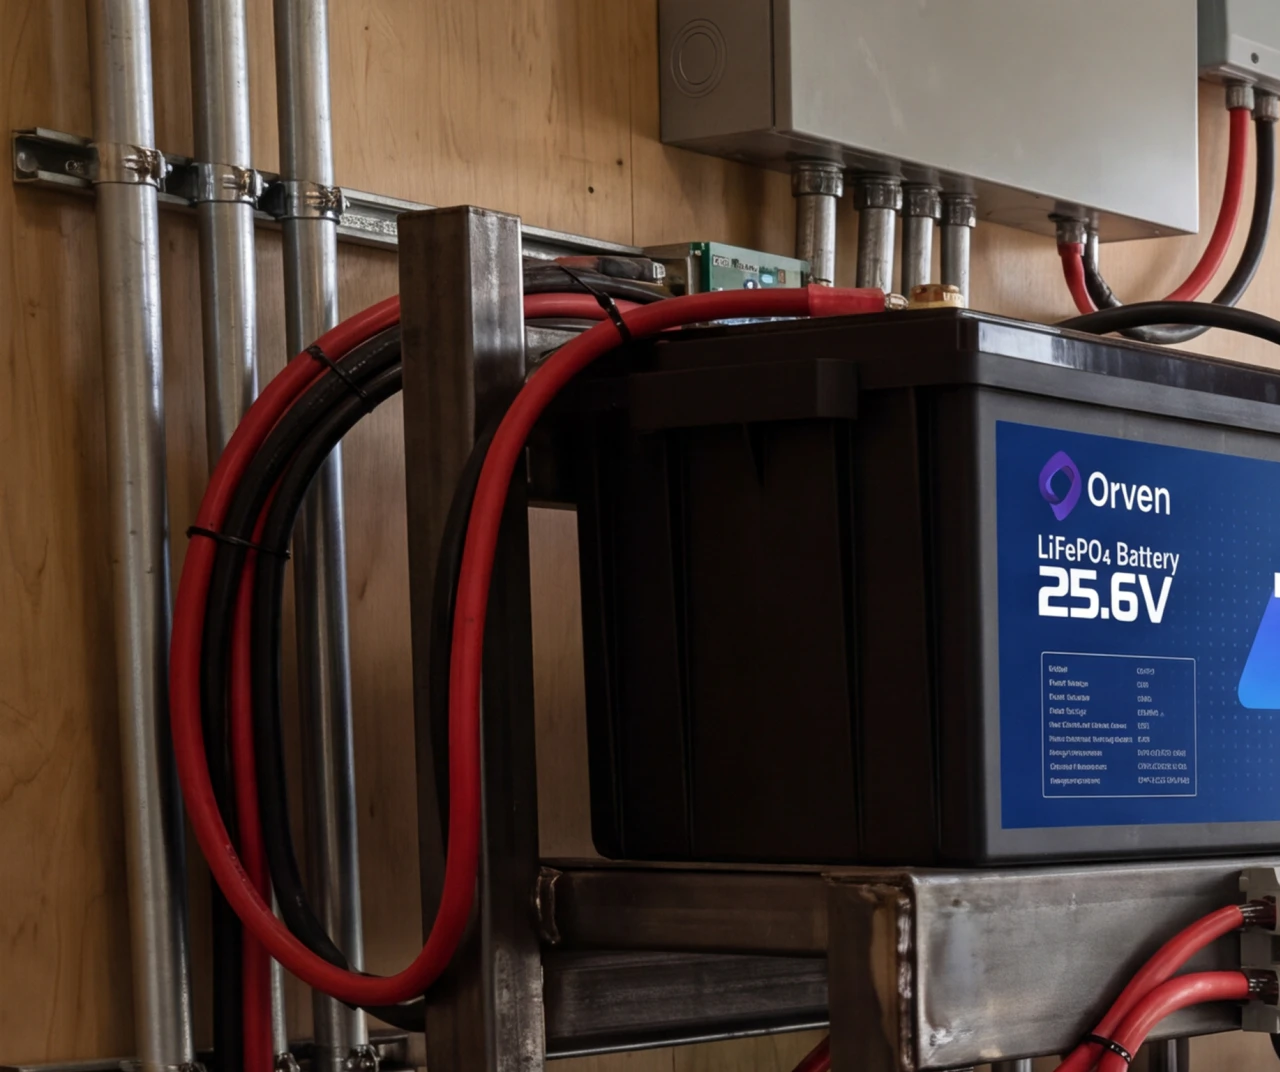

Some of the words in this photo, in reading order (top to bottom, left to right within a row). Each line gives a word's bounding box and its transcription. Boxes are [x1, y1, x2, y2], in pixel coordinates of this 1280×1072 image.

[1087, 471, 1171, 515] Orven
[1116, 541, 1180, 576] Battery
[1038, 565, 1173, 624] 25.6V
